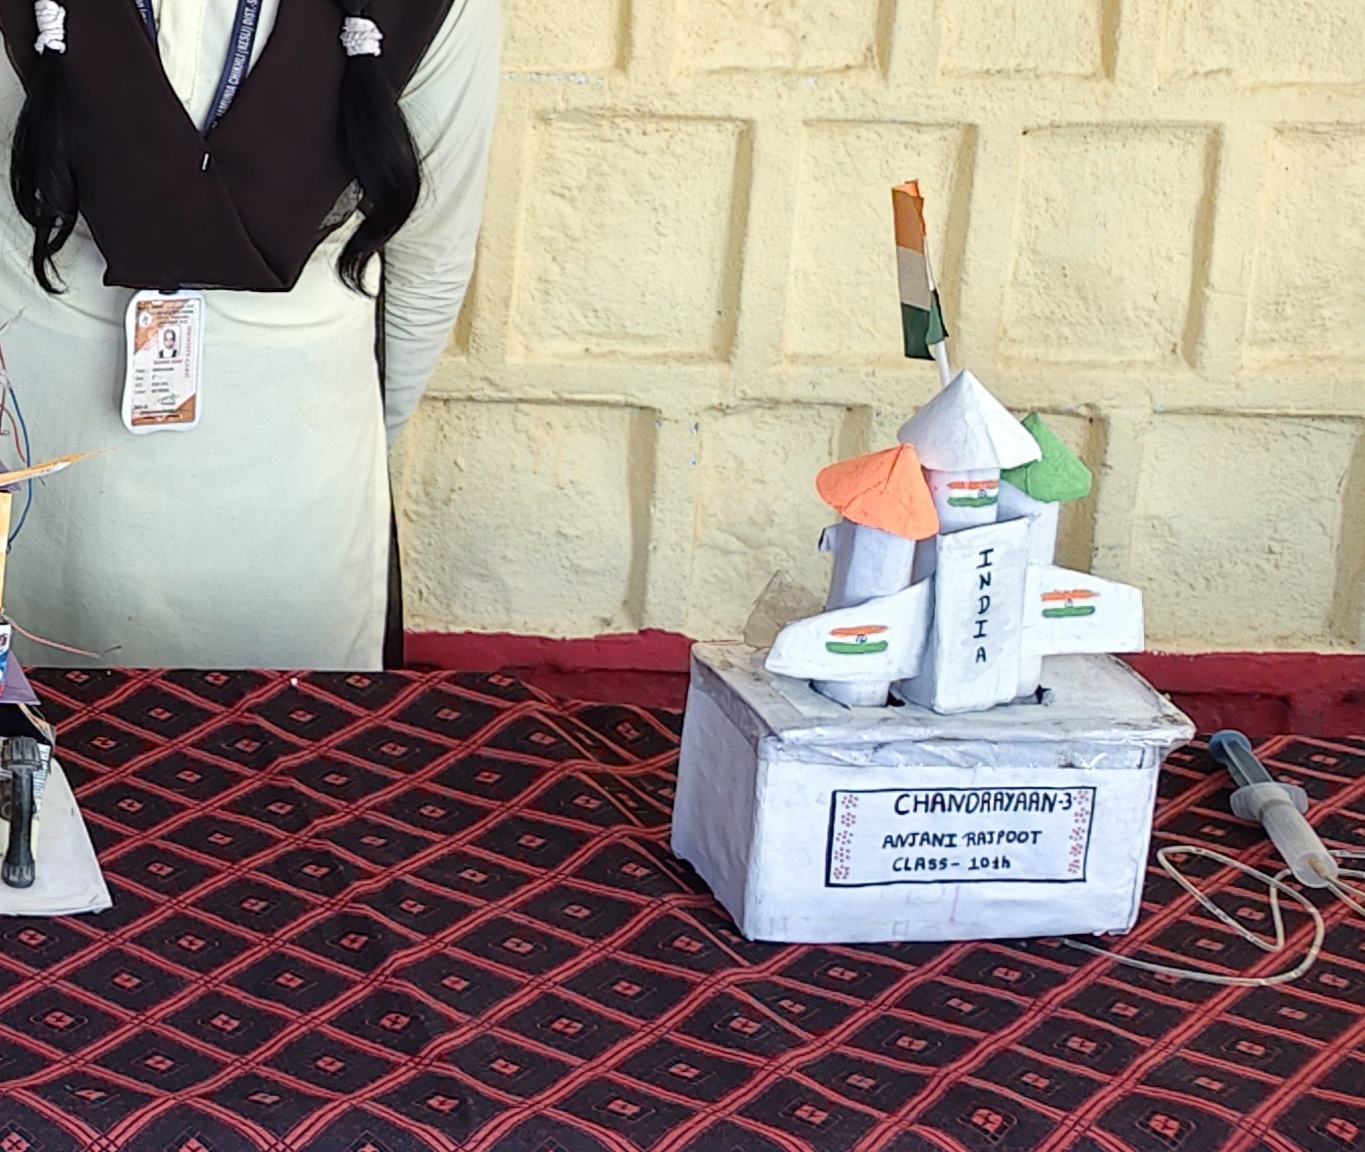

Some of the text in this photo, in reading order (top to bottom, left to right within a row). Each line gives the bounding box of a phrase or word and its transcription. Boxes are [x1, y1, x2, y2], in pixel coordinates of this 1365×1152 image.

[972, 547, 994, 663] INDIA
[882, 830, 1043, 849] ANJANI RAJPOOT
[970, 856, 1011, 870] 10th
